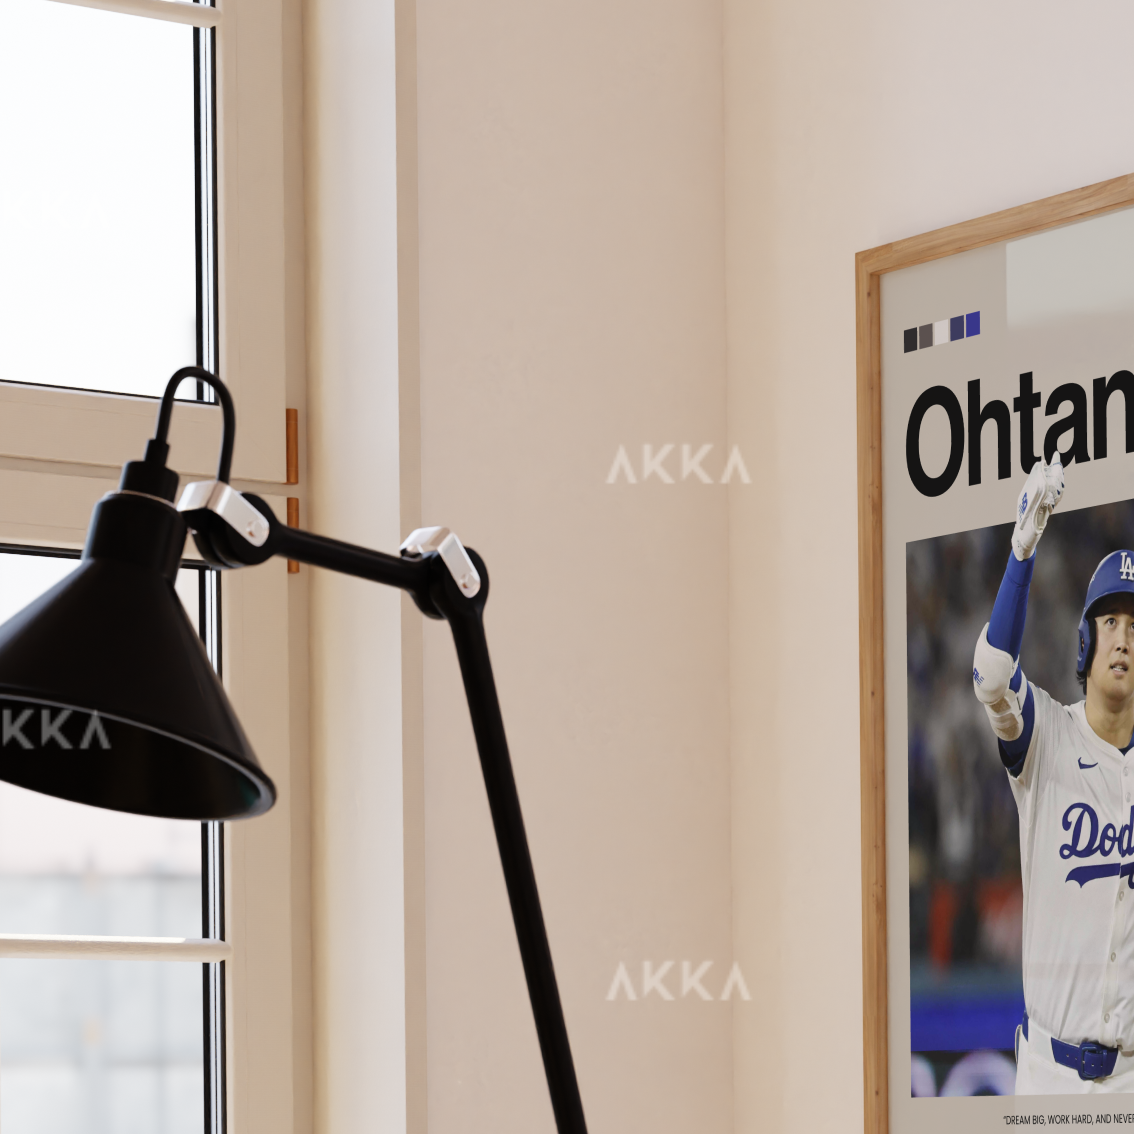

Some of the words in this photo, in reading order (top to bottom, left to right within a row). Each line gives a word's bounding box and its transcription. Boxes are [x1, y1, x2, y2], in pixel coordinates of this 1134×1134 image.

[1120, 552, 1134, 581] LA
[1032, 1115, 1046, 1126] BIG,
[1047, 1115, 1070, 1125] WORK
[1072, 1114, 1094, 1125] HARD,
[1095, 1114, 1111, 1124] AND
